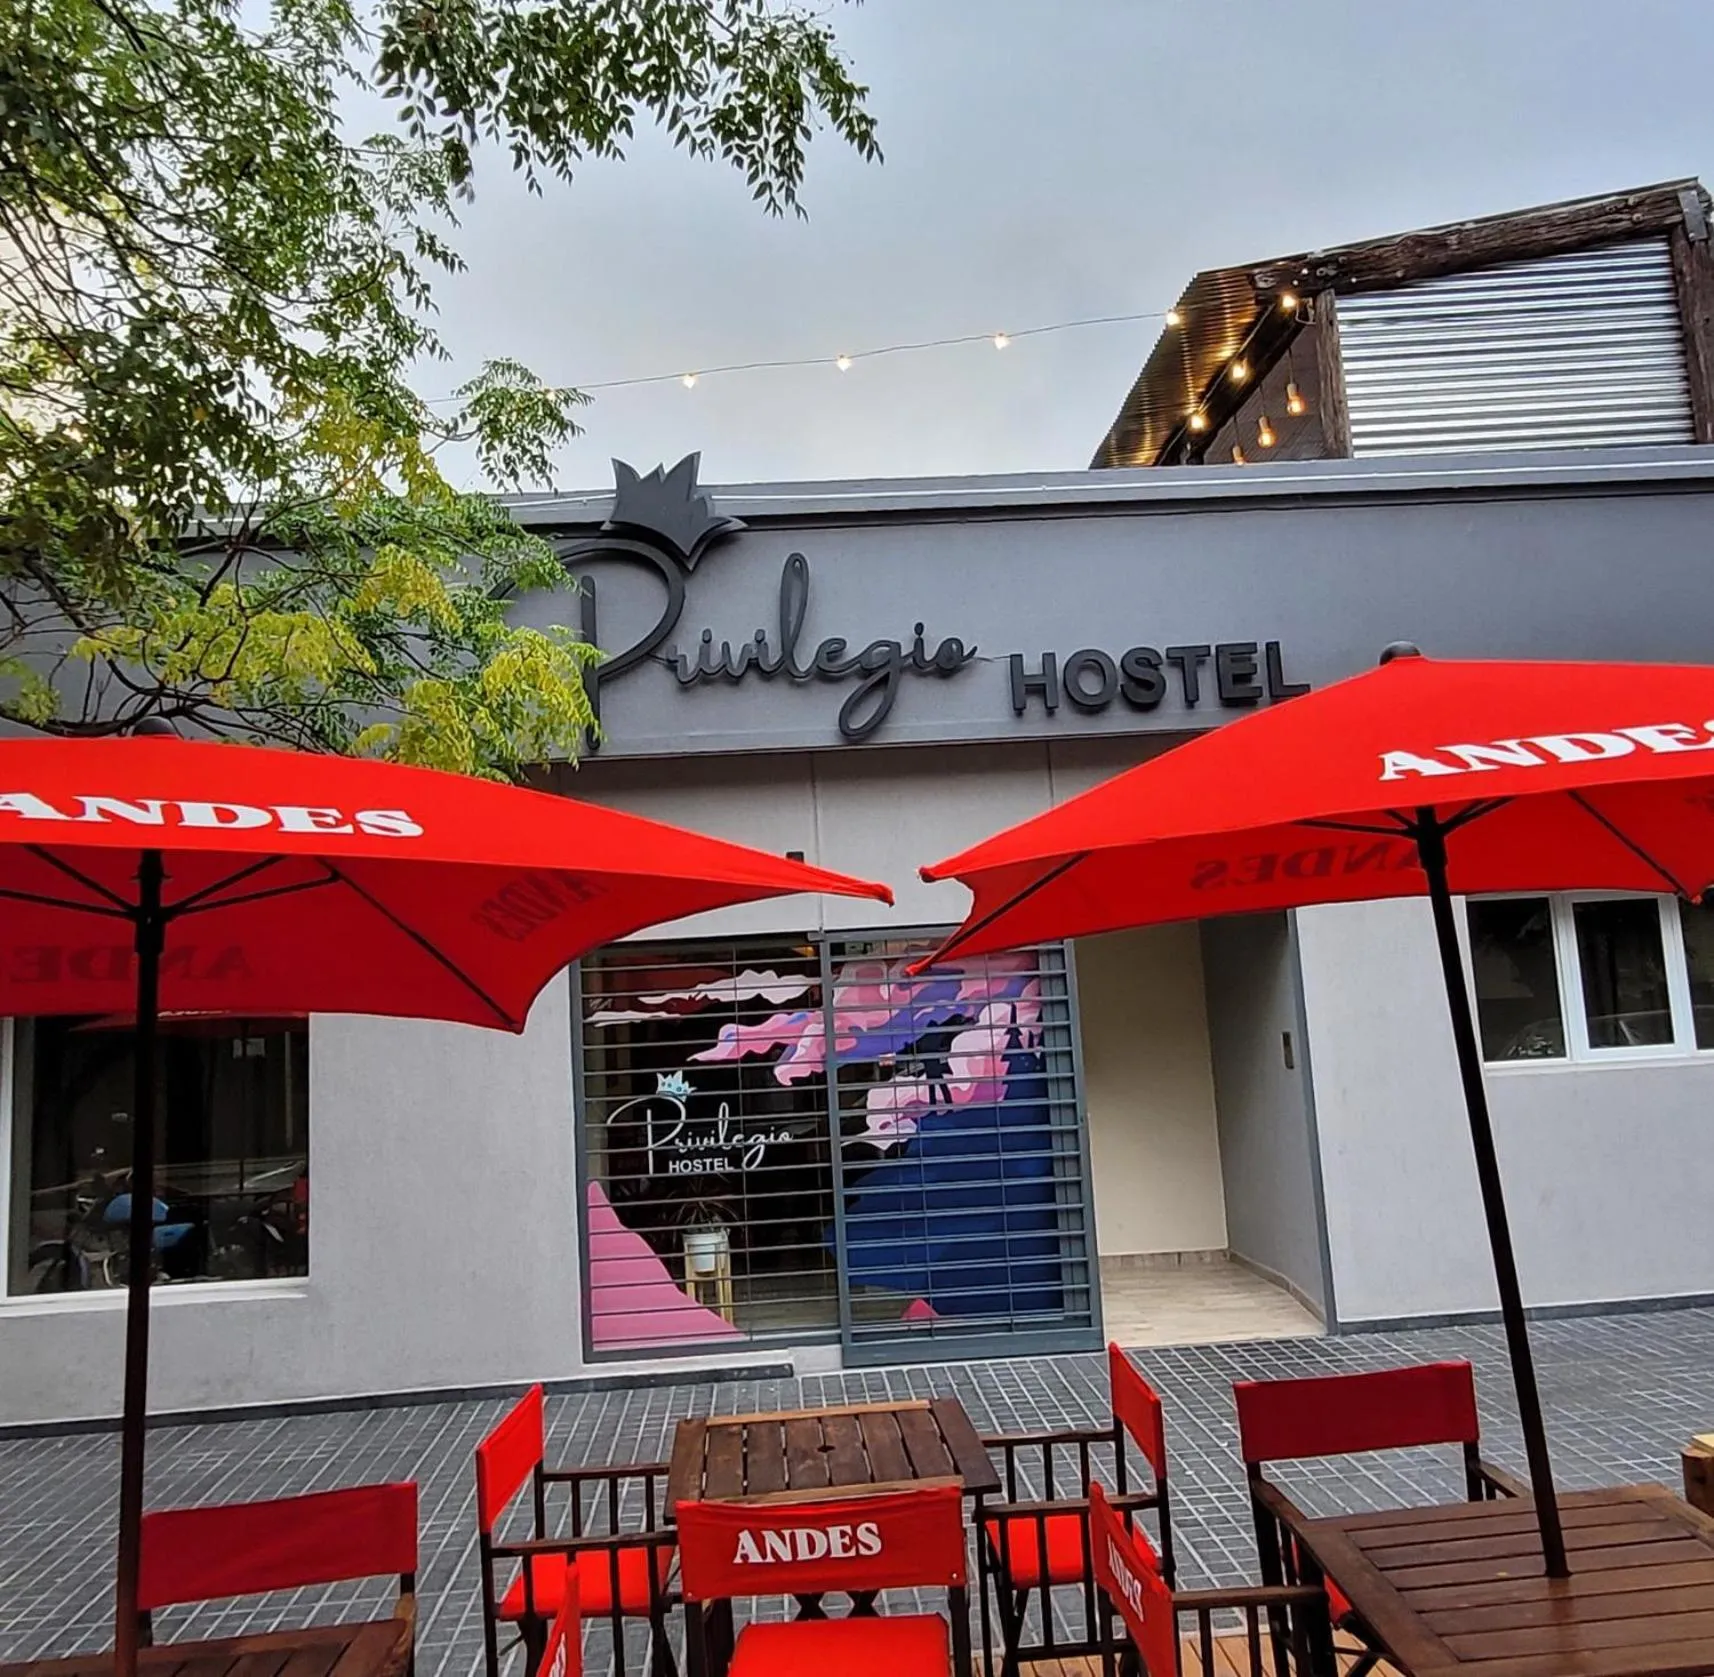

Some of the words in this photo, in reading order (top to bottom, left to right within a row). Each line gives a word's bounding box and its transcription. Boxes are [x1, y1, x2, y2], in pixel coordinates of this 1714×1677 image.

[487, 537, 977, 750] Privilegio
[1009, 640, 1311, 712] HOSTEL
[1378, 720, 1714, 781] ANDE
[0, 792, 424, 837] ANDES
[606, 1095, 794, 1175] Privilegio
[668, 1157, 734, 1174] HOSTEL
[732, 1522, 882, 1564] ANDES
